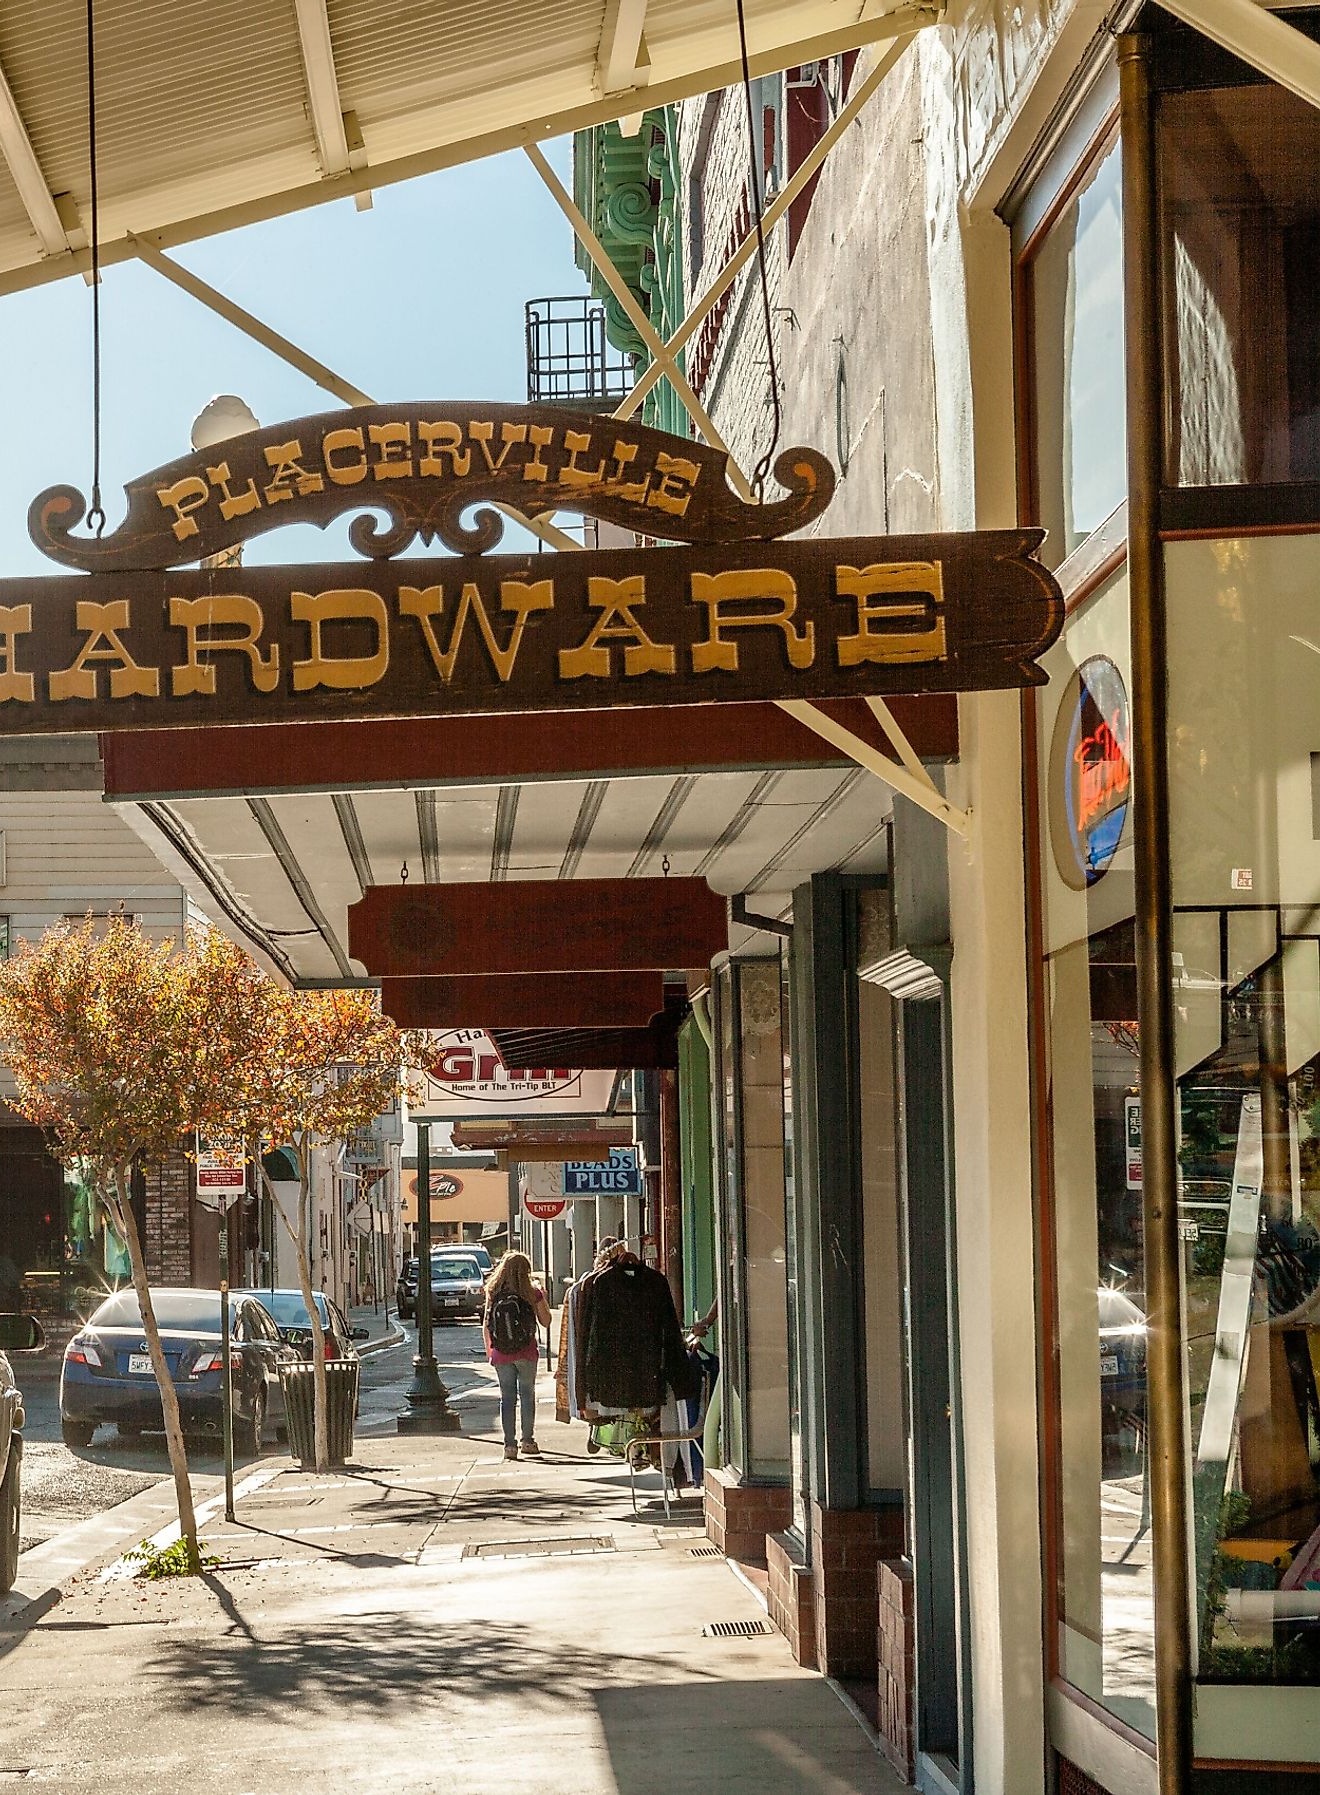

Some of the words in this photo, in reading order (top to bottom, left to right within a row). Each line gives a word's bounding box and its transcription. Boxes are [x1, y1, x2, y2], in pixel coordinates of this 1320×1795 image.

[157, 420, 702, 539] PLACERVILLE
[451, 1083, 476, 1091] Home
[479, 1083, 488, 1091] of
[491, 1083, 507, 1091] The
[511, 1082, 539, 1091] Tri-Tip
[542, 1081, 557, 1089] BLT
[576, 1172, 629, 1188] PLUS
[533, 1205, 557, 1213] ENTER
